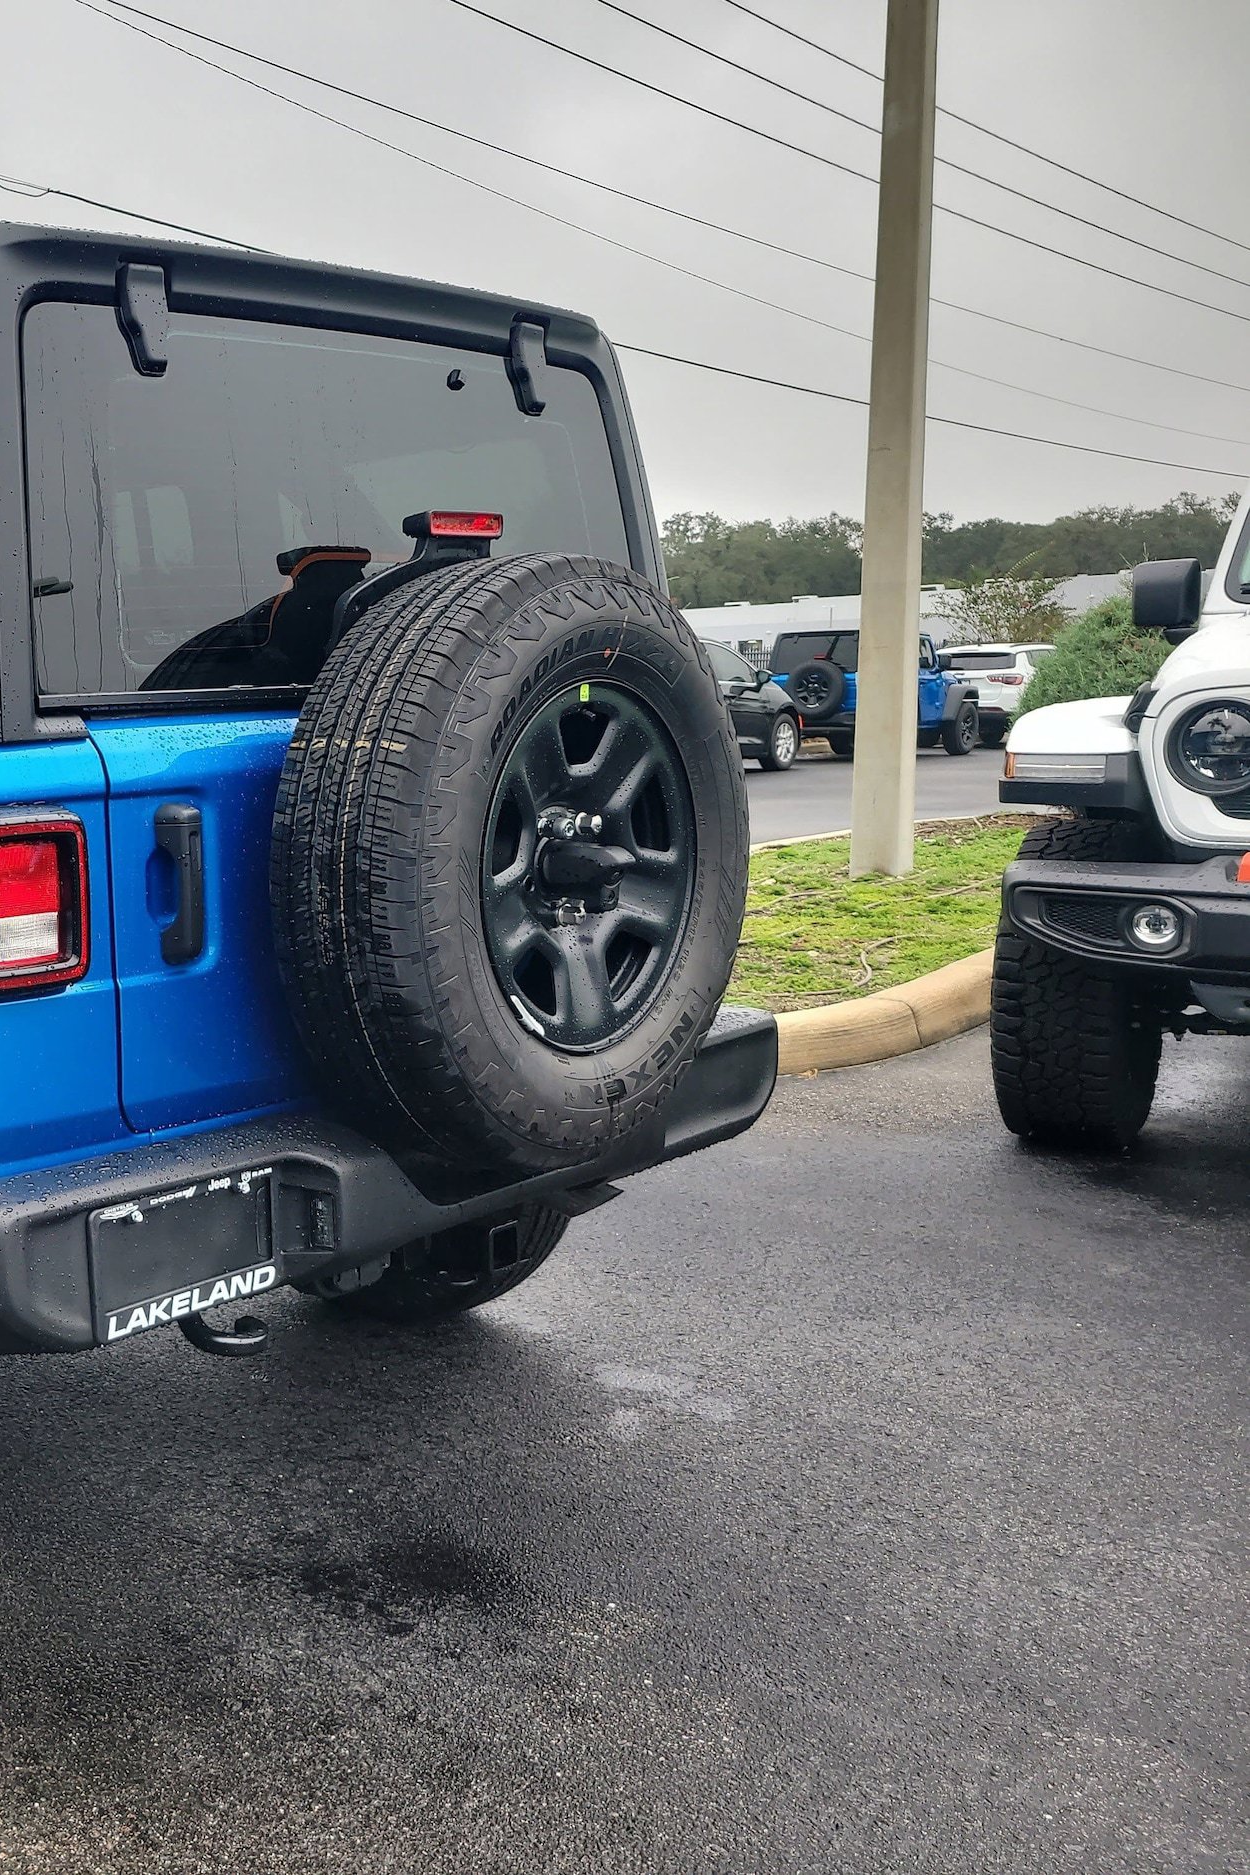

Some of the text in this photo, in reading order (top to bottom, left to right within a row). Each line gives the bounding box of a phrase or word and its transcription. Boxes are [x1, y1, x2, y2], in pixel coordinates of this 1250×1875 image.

[490, 629, 595, 758] ROADIAN
[579, 1011, 694, 1104] NEXEN
[207, 1176, 231, 1192] Jeep
[251, 1166, 272, 1178] RAM
[107, 1265, 276, 1340] LAKELAND
